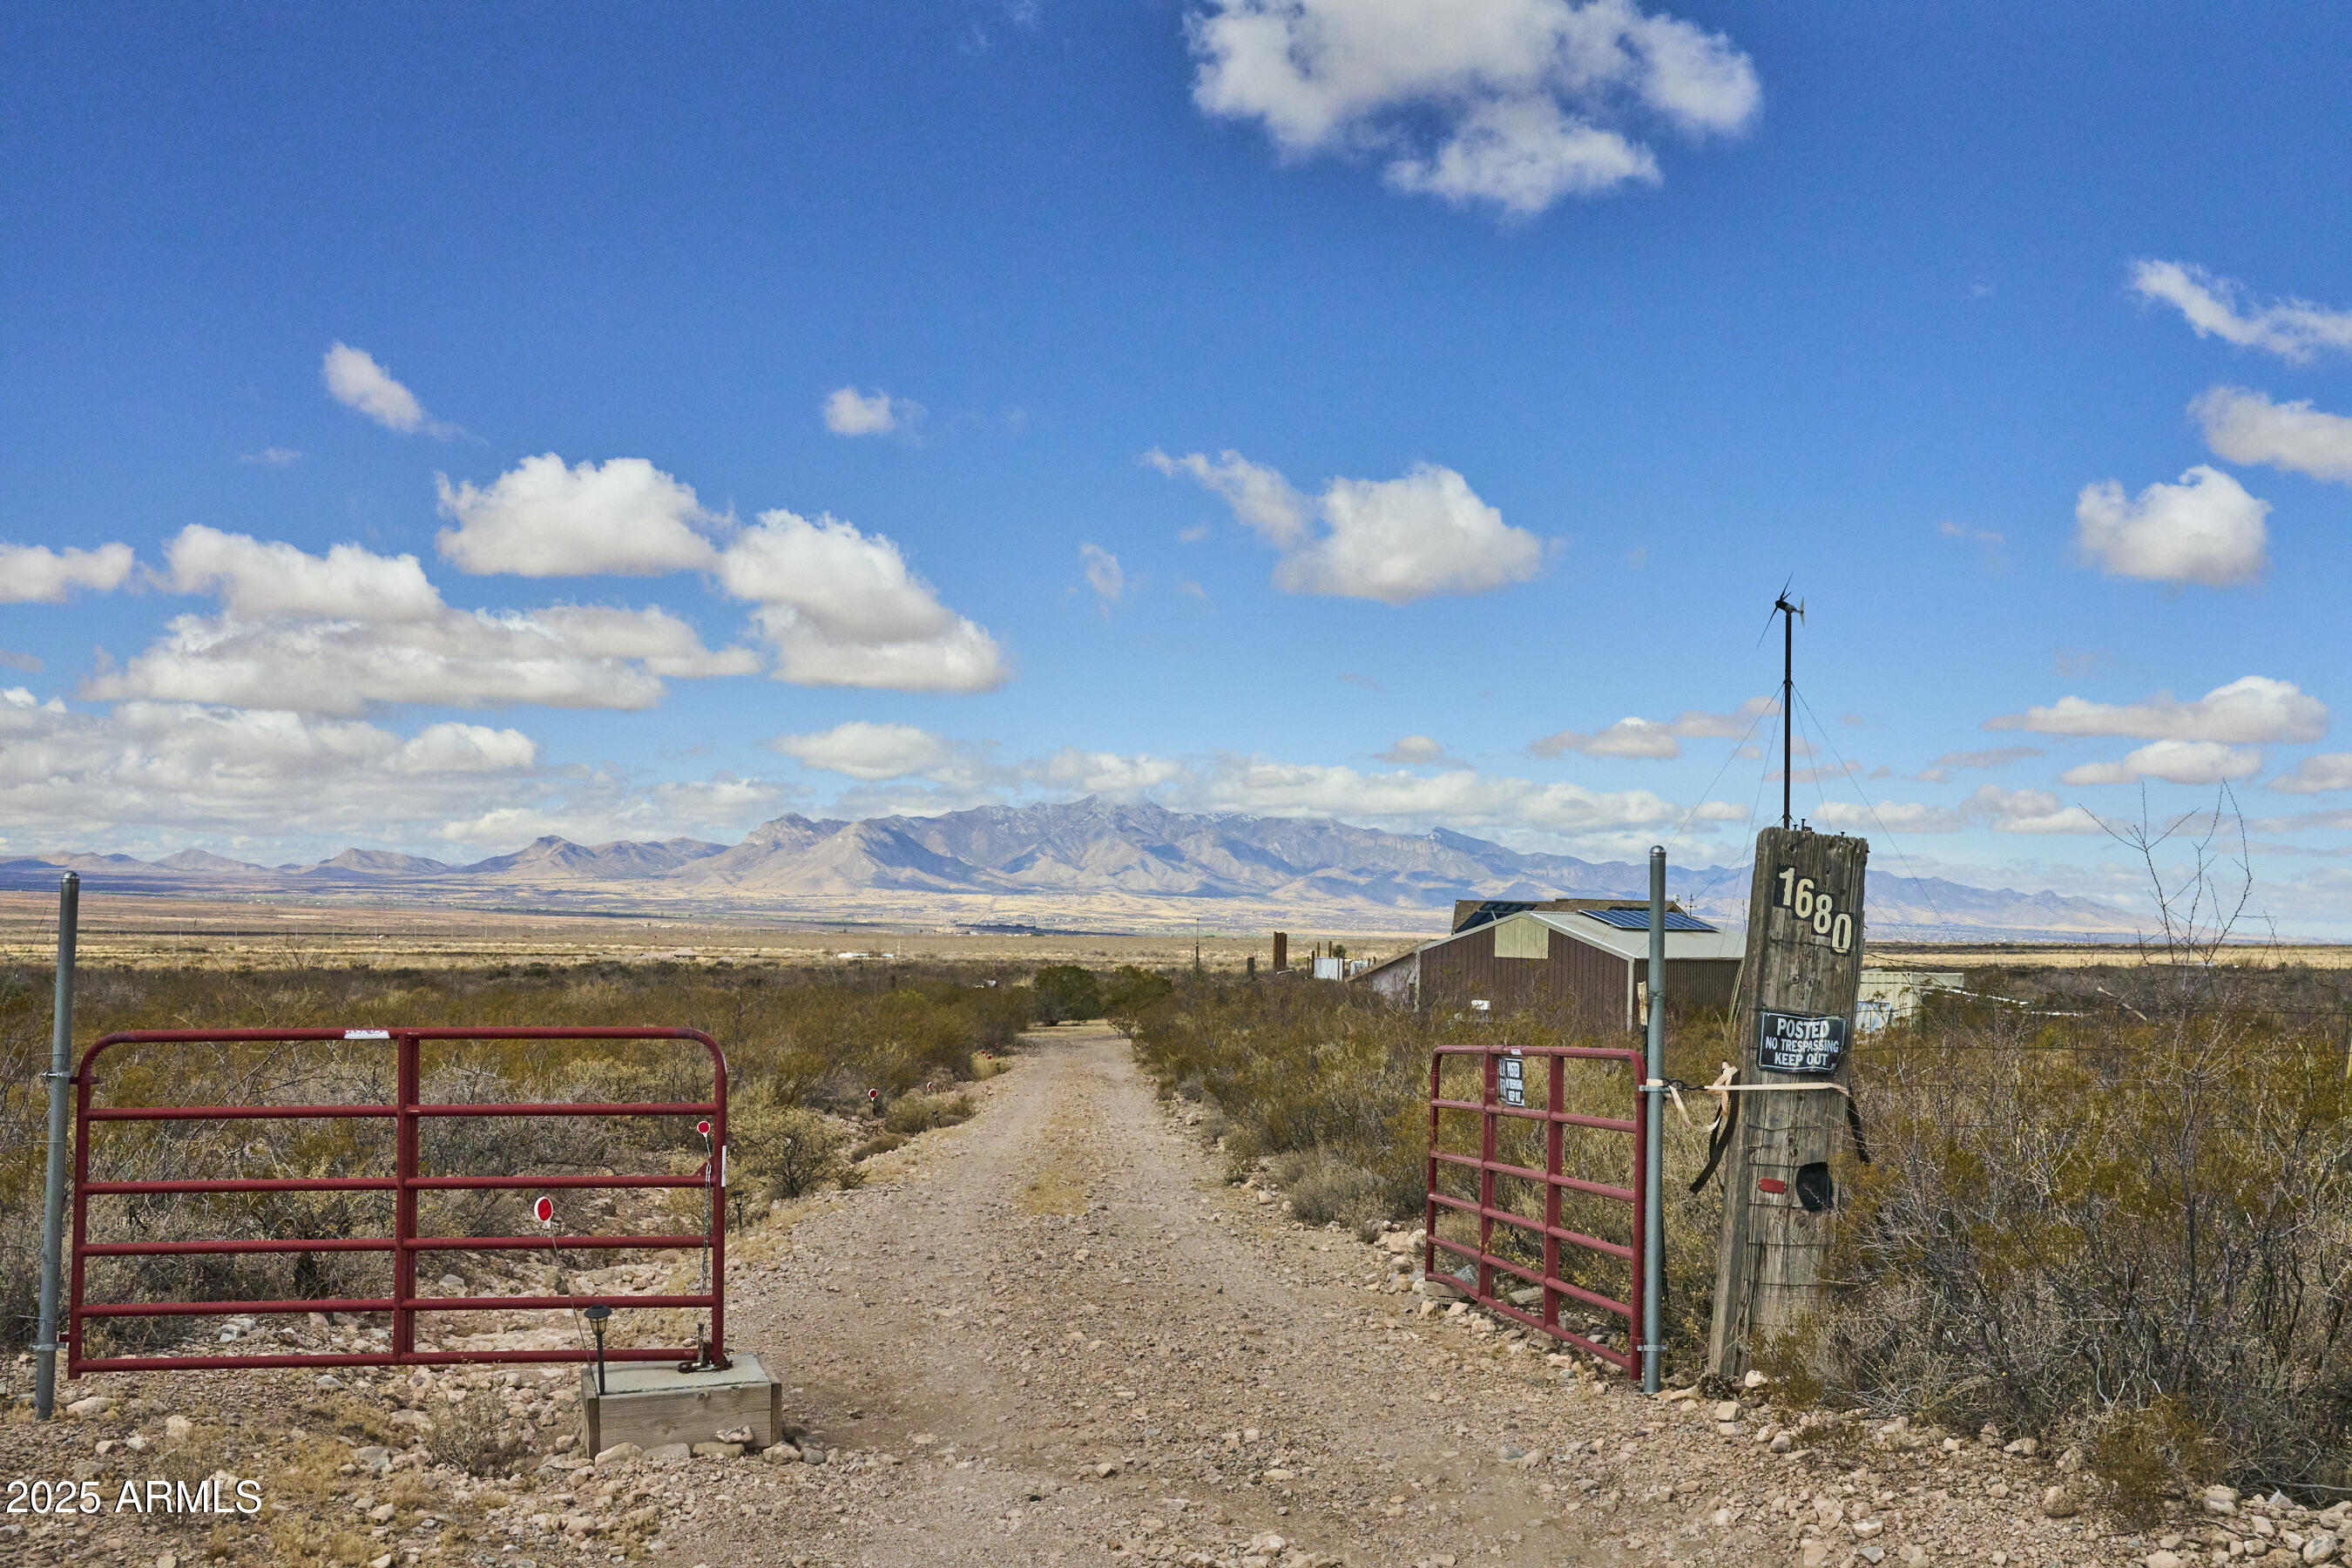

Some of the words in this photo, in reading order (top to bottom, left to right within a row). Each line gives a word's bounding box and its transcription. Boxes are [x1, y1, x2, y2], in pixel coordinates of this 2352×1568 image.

[1779, 868, 1852, 953] 1680
[1777, 1017, 1829, 1038] POSTED
[1765, 1036, 1778, 1050] NO
[1781, 1038, 1839, 1053] TRESPASSING
[1774, 1052, 1803, 1066] KEEP
[1807, 1052, 1828, 1066] OUT
